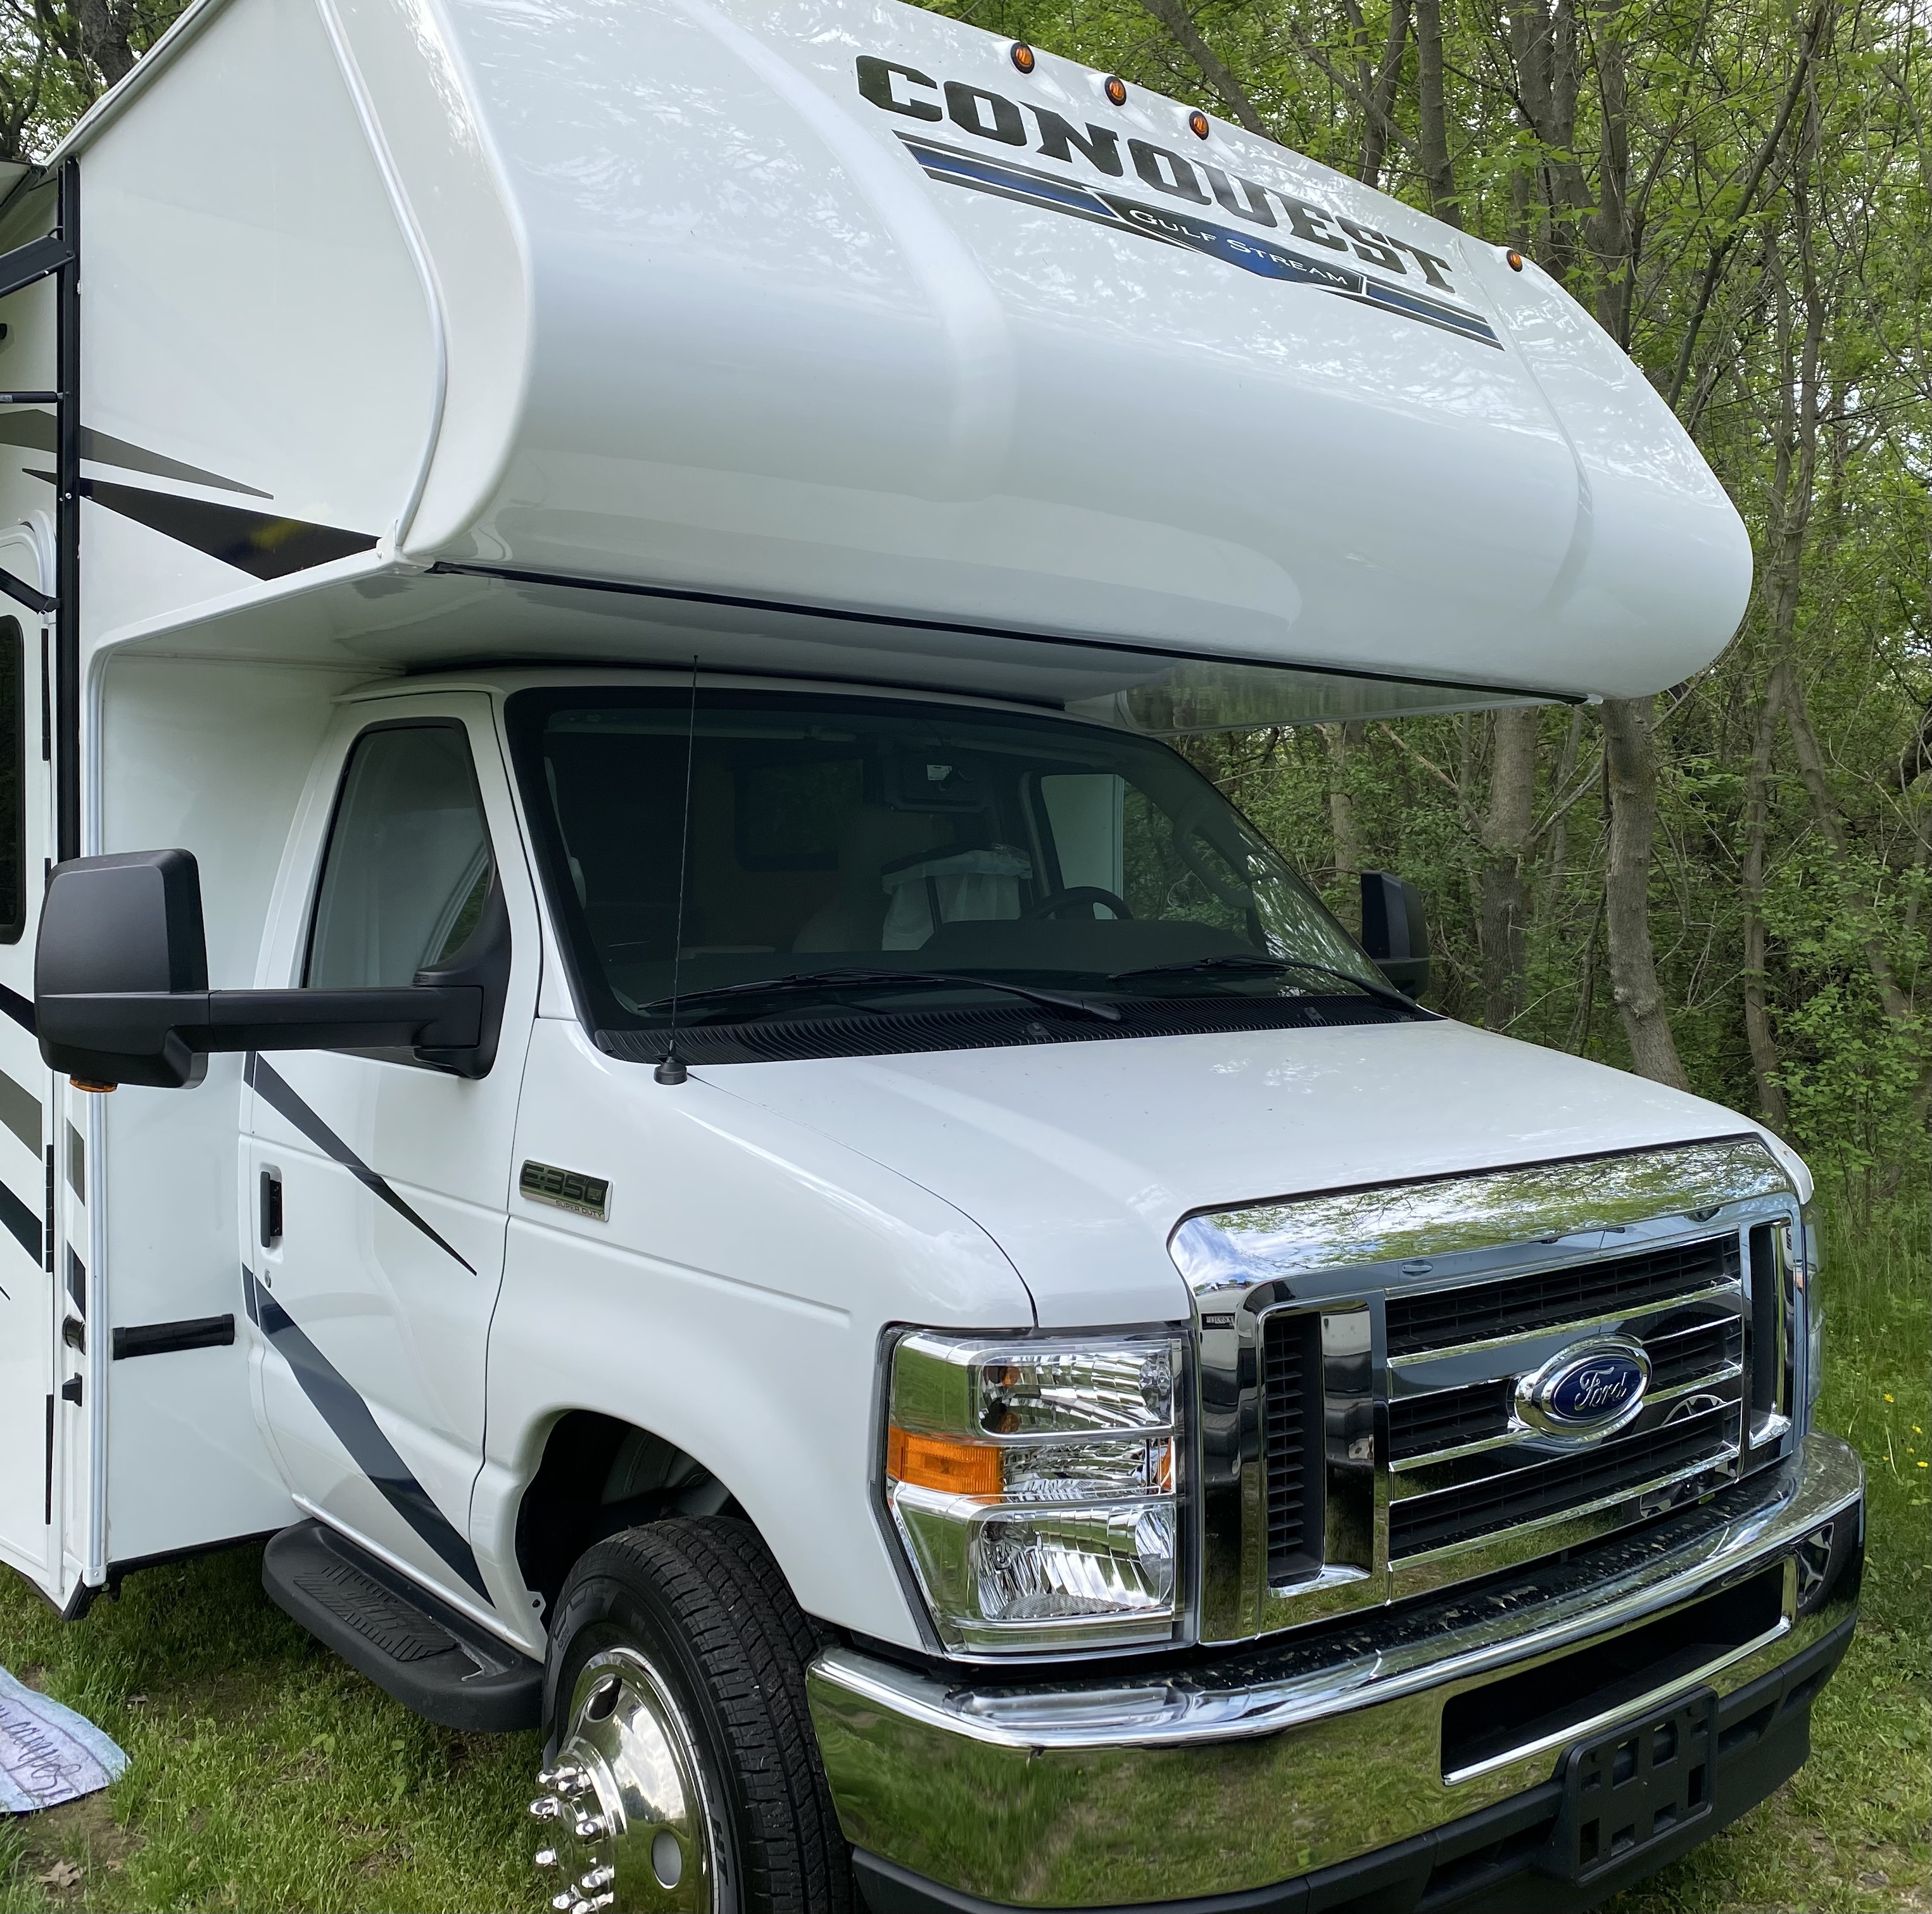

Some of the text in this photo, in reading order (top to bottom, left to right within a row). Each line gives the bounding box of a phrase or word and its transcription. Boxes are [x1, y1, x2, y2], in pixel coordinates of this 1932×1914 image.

[856, 55, 1455, 294] CONQUEST
[1129, 209, 1349, 285] GULF STREAM
[555, 1200, 605, 1218] SUPER DUTY
[1574, 1366, 1629, 1411] Ford
